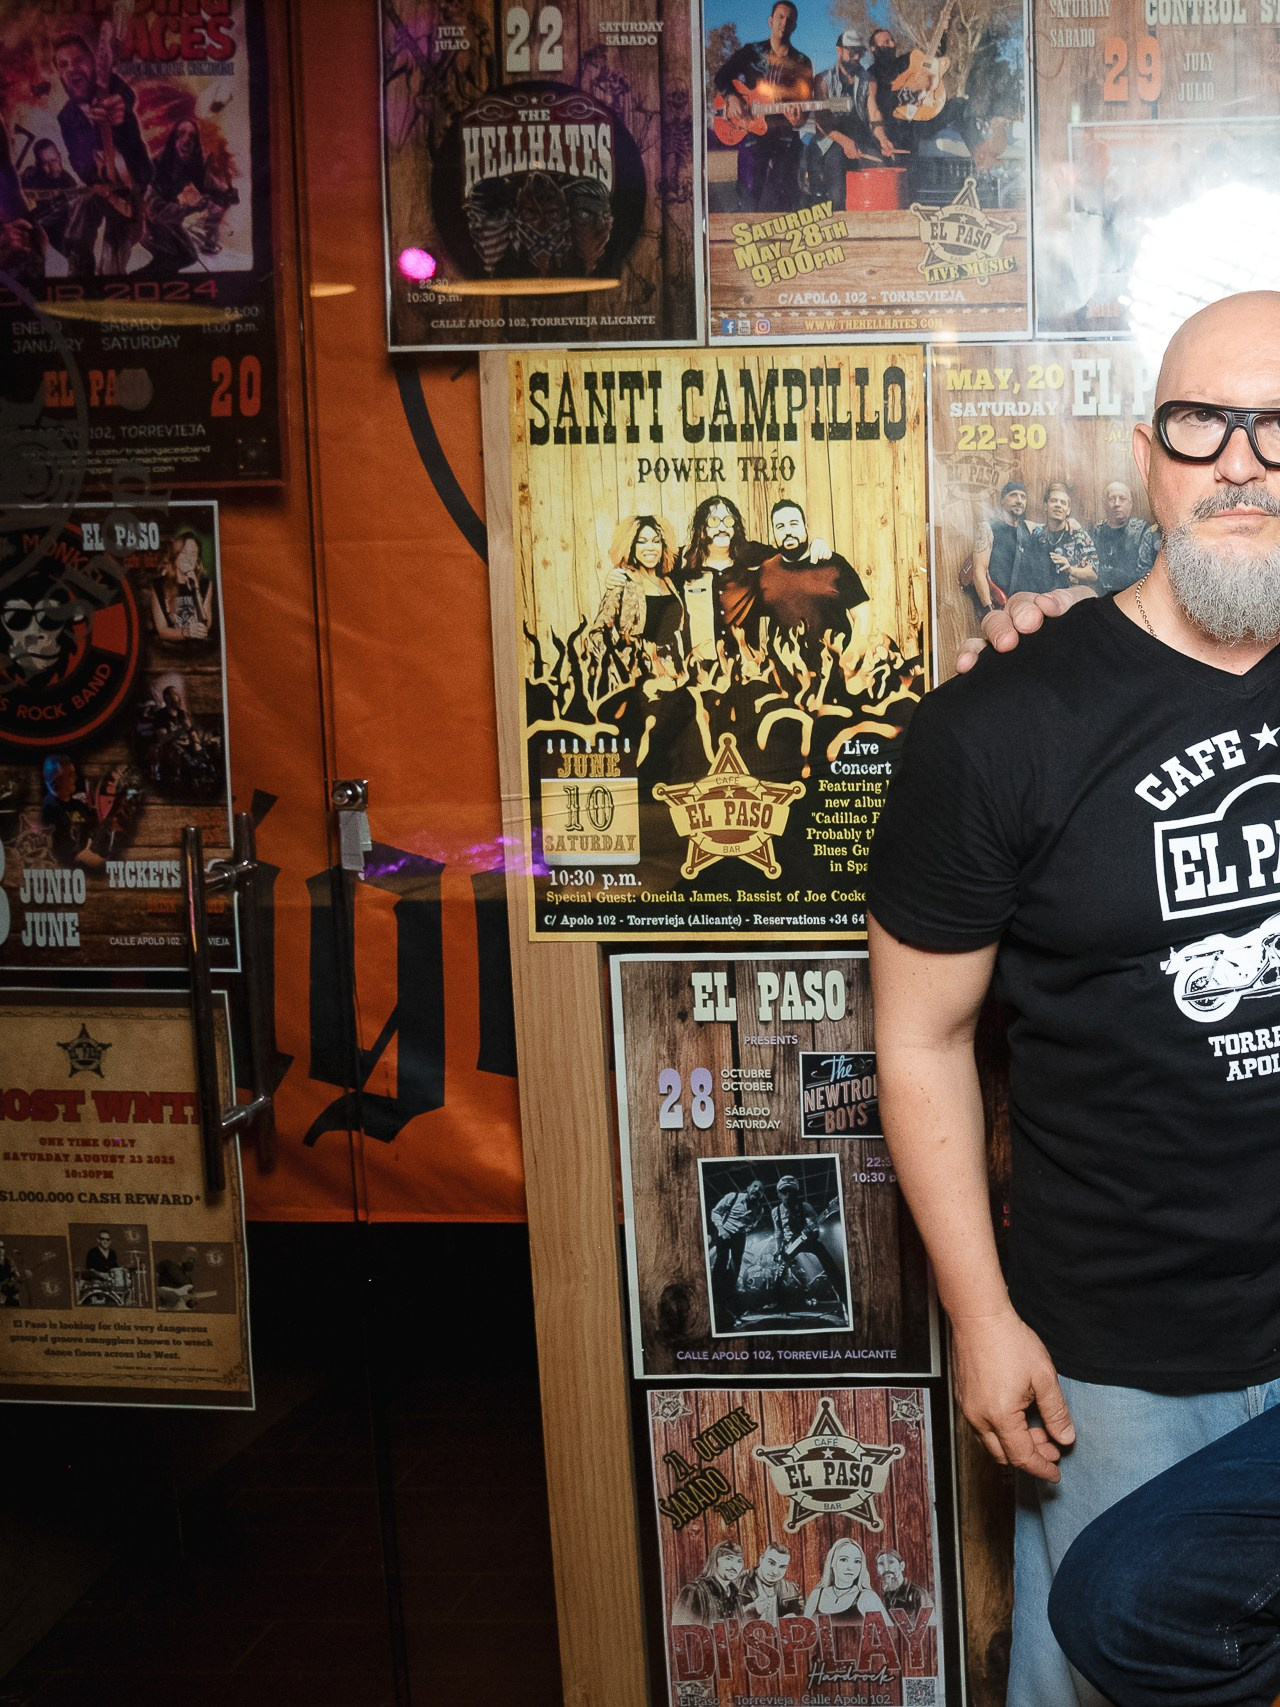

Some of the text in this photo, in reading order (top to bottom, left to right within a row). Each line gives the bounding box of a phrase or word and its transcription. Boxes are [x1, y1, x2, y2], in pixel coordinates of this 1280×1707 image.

[1144, 0, 1247, 26] CONTROL
[438, 26, 466, 40] JULY
[598, 21, 664, 34] SATURDAY
[434, 39, 471, 53] JULIO
[505, 5, 564, 73] 22
[1103, 35, 1163, 102] 29
[518, 108, 551, 122] THE
[462, 122, 614, 200] HELLHATES
[930, 221, 993, 251] EL PASO
[924, 256, 1015, 283] LIVE MUSIC
[103, 279, 219, 302] 2024
[880, 289, 966, 304] TORREVIEJA
[431, 315, 656, 330] CALLE APOLO TORREVIEJA ALICANTE
[101, 335, 181, 351] SATURDAY
[210, 354, 263, 418] 20
[945, 363, 1065, 395] MAY, 20
[1071, 357, 1123, 417] EL
[528, 365, 908, 447] SANTI CAMPILLO
[949, 399, 1060, 419] SATURDAY
[119, 423, 208, 440] TORREVIEJA
[957, 423, 1048, 452] 22-30
[636, 455, 727, 484] POWER
[81, 521, 161, 551] EL PASO
[71, 663, 112, 711] BAND
[16, 703, 67, 721] ROCK
[843, 739, 880, 756] Live
[557, 753, 622, 779] JUNE
[830, 760, 893, 775] Concert
[1134, 729, 1247, 812] CAFE
[817, 779, 883, 795] Featuring
[563, 784, 617, 833] 10
[824, 798, 851, 809] new
[684, 802, 775, 831] EL PASO
[544, 833, 639, 853] SATURDAY
[806, 827, 863, 843] Probably
[722, 844, 742, 855] BAR
[812, 844, 848, 857] Blues
[105, 860, 183, 889] TICKETS
[829, 860, 843, 872] in
[1168, 832, 1240, 902] EL
[19, 868, 87, 905] JUNIO
[549, 869, 642, 890] 10:30 p.m.
[545, 889, 828, 905] Special Guest: Oneida James. Bassist of Joe
[560, 912, 849, 928] Apolo 102 Torrevieja (Alicante) Reservations +34
[21, 911, 82, 949] JUNE
[109, 937, 165, 947] CALLE APOLO
[690, 969, 846, 1023] EL PASO
[743, 1035, 799, 1047] PRESENTS
[720, 1068, 772, 1080] OCTUBRE
[720, 1081, 774, 1093] OCTOBER
[657, 1066, 715, 1130] 28
[724, 1104, 771, 1117] SÁBADO
[823, 1102, 869, 1134] BOYS
[725, 1119, 782, 1131] SATURDAY
[39, 1136, 65, 1148] ONE
[67, 1137, 100, 1148] TIME
[3, 1152, 176, 1165] SATURDAY AUGUST 2025
[852, 1171, 886, 1184] 10:30
[77, 1192, 121, 1205] CASH
[676, 1349, 898, 1361] CALLE APOLO 102, TORREVIEJA ALICANTE
[692, 1406, 759, 1462] OCTUBRE
[784, 1461, 874, 1490] EL PASO
[823, 1502, 842, 1511] BAR
[808, 1661, 896, 1690] Hardrock
[734, 1693, 868, 1707] Torrevieja Calle Apolo
